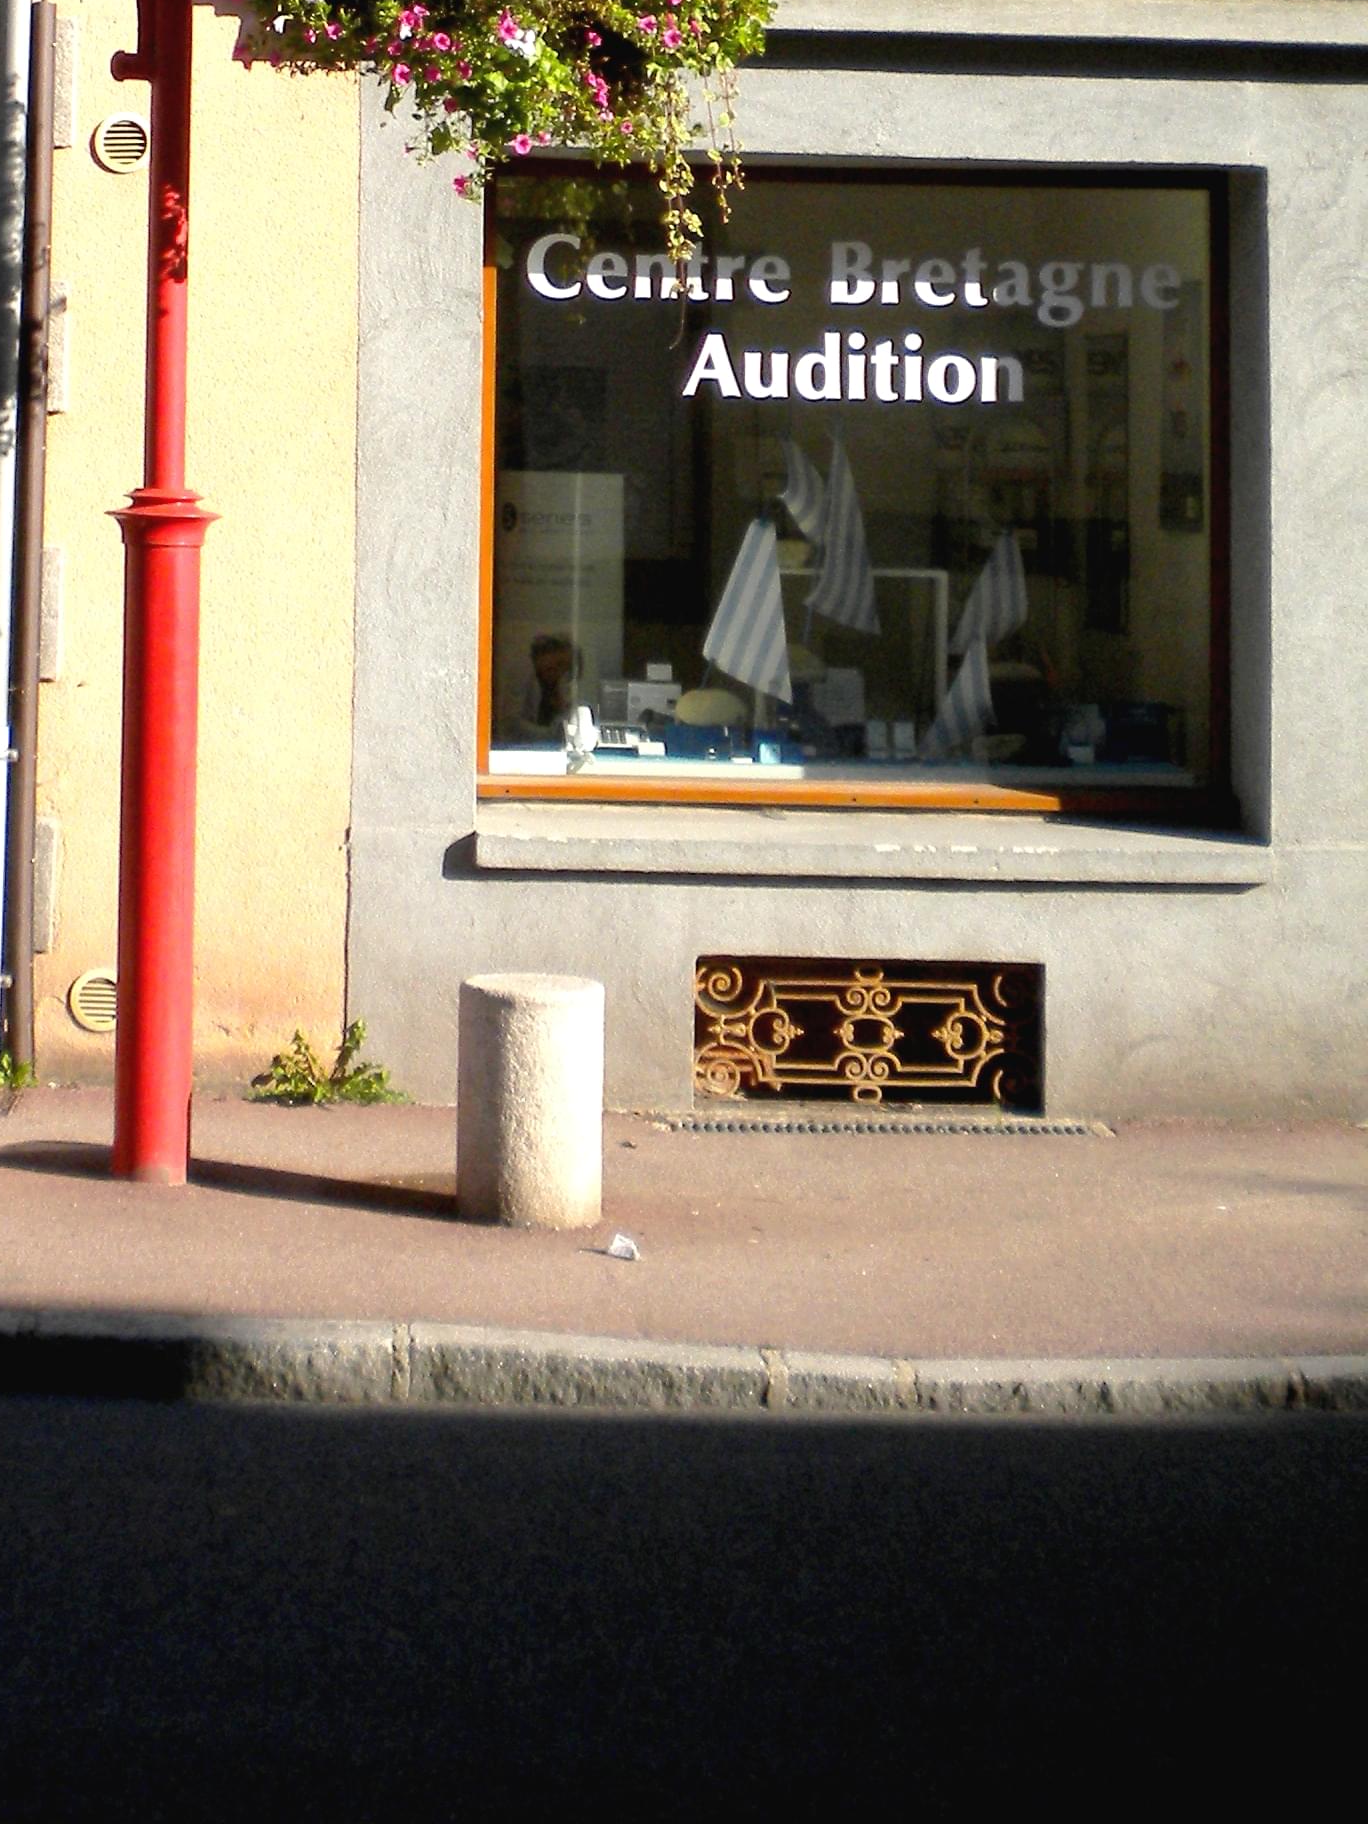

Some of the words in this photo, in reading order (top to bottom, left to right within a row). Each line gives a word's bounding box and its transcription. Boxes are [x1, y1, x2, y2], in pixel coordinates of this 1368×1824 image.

[526, 232, 790, 304] Centre
[830, 240, 1183, 327] Bretagne
[682, 331, 1025, 405] Audition
